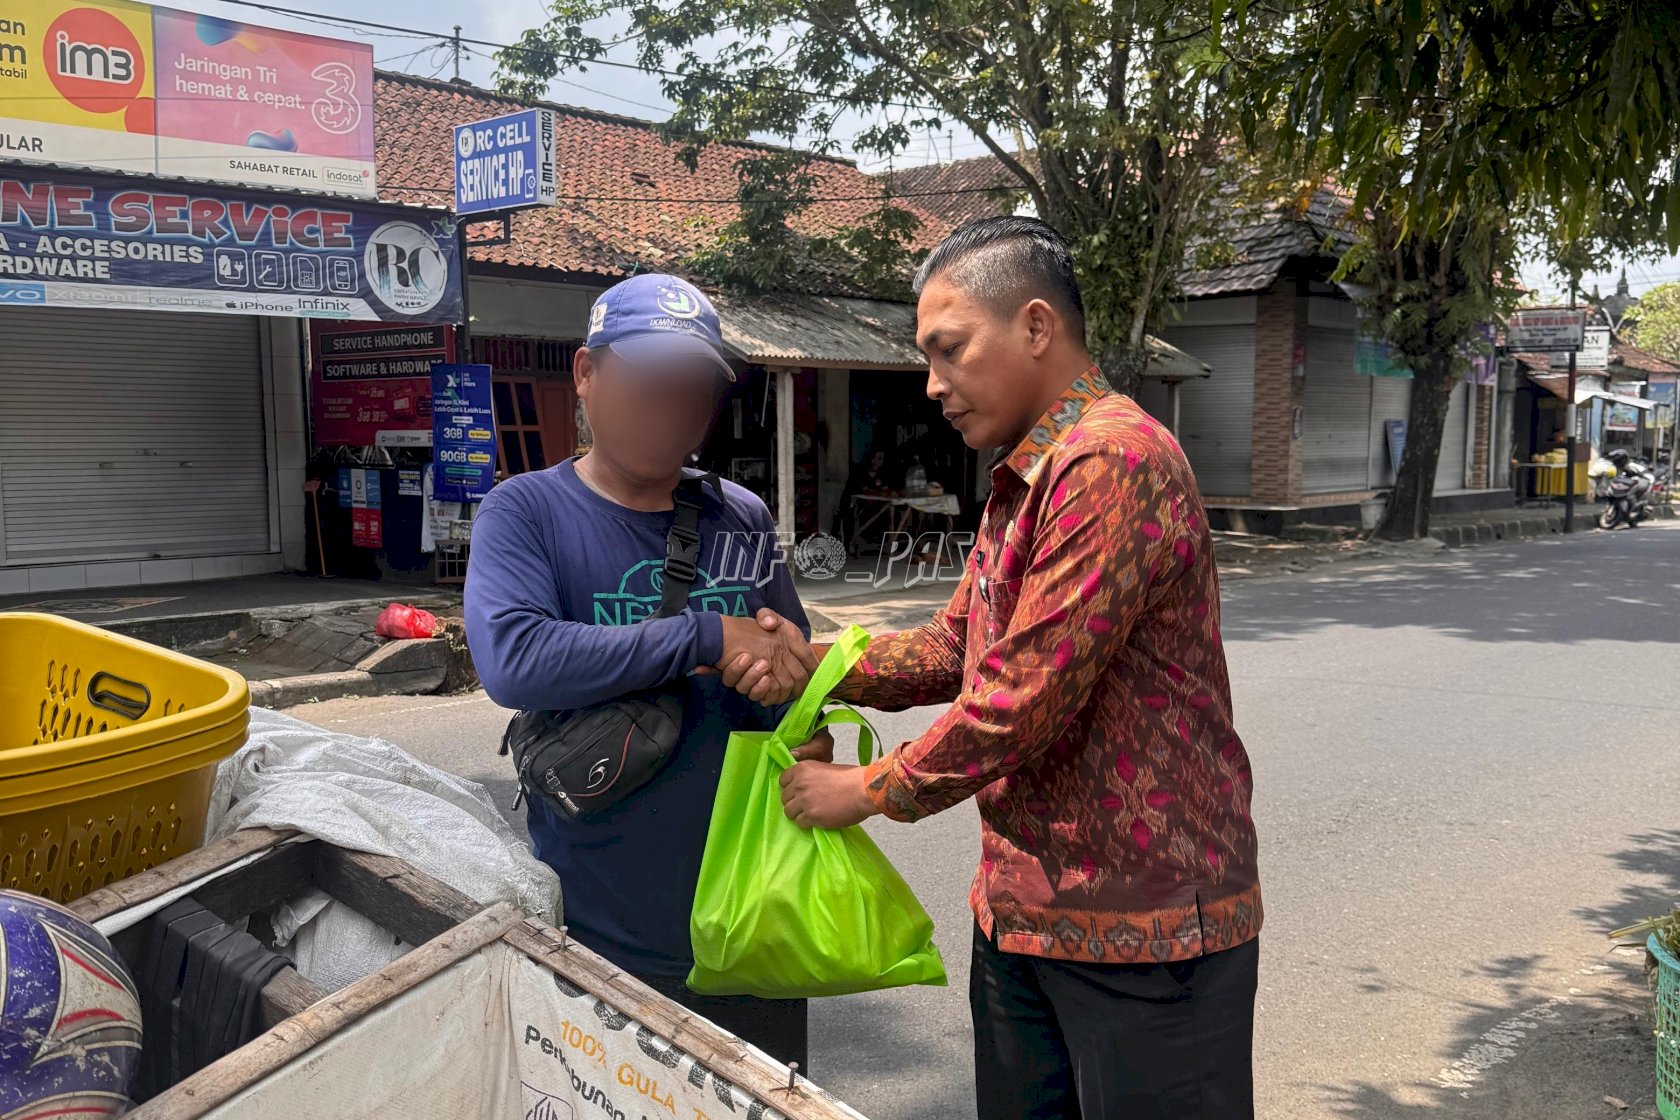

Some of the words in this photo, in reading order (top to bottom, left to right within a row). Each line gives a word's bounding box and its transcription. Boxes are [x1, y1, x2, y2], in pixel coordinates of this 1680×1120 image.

[174, 53, 252, 80] Jaringan
[256, 65, 277, 84] Tri
[175, 75, 233, 99] hemat
[237, 85, 249, 101] &
[254, 91, 305, 110] cepat.
[475, 128, 493, 152] RC
[496, 121, 531, 148] CELL
[541, 111, 553, 183] SERVICE
[229, 160, 280, 174] SAHABAT
[282, 166, 318, 179] RETAIL
[326, 169, 363, 183] indosat
[460, 153, 506, 204] SERVICE
[509, 150, 524, 196] HP
[541, 185, 555, 197] HP
[35, 235, 204, 264] ACCESORIES
[0, 255, 111, 279] RDWARE
[149, 295, 213, 307] realme
[240, 301, 294, 312] iPhone
[298, 298, 350, 311] Infinix
[650, 318, 692, 329] DOWNLOAD
[333, 336, 372, 350] SERVICE
[375, 332, 434, 348] HANDPHONE
[326, 362, 378, 377] SOFTWARE
[379, 363, 388, 374] &
[443, 427, 463, 439] 3GB
[440, 450, 467, 462] 90GB
[561, 1020, 607, 1070] 100%
[617, 1062, 676, 1116] GULA
